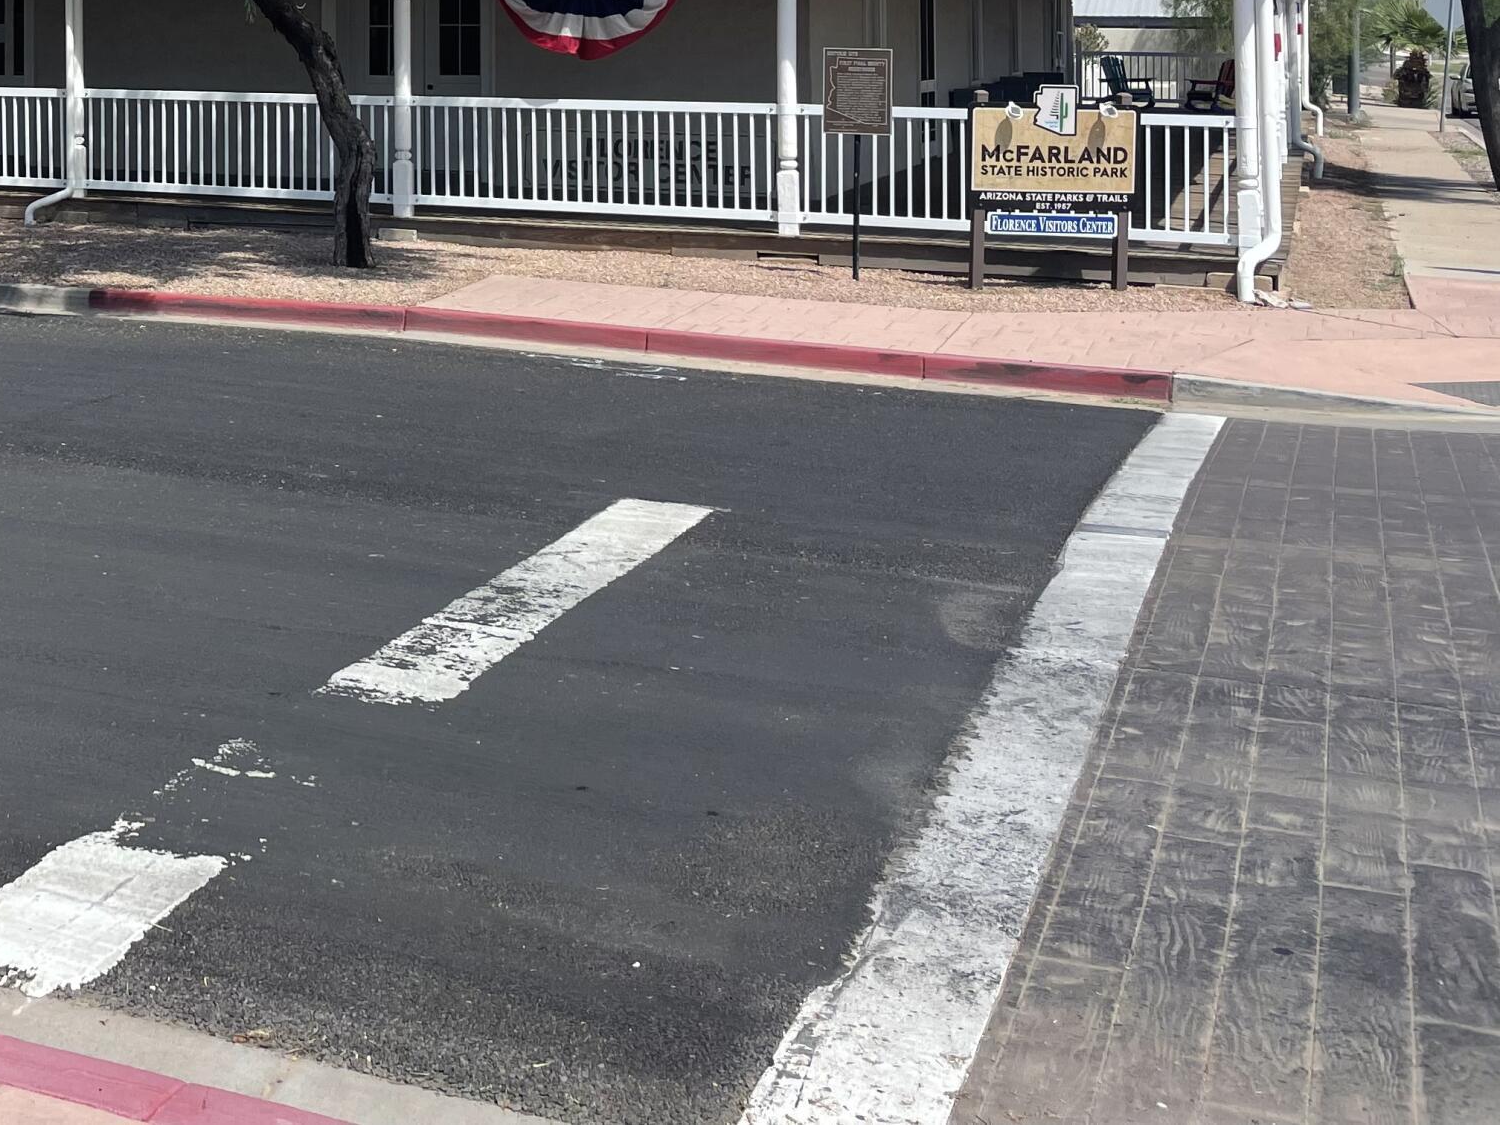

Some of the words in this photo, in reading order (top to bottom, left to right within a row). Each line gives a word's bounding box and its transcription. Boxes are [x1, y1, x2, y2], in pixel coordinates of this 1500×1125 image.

[586, 137, 718, 162] FLORENCE
[981, 144, 1128, 165] McFARLAND
[656, 162, 753, 186] CENTER
[980, 164, 1022, 176] STATE
[1026, 165, 1089, 178] HISTORIC
[1093, 166, 1128, 178] PARK
[979, 192, 1023, 201] ARIZONA
[1025, 193, 1053, 202] STATE
[1055, 193, 1084, 202] PARKS
[1086, 193, 1094, 202] &
[1097, 194, 1128, 203] TRAILS
[1035, 202, 1052, 210] EST.
[991, 215, 1037, 232] FLORENCE
[1038, 216, 1078, 233] VISITORS
[1079, 217, 1114, 234] CENTER
